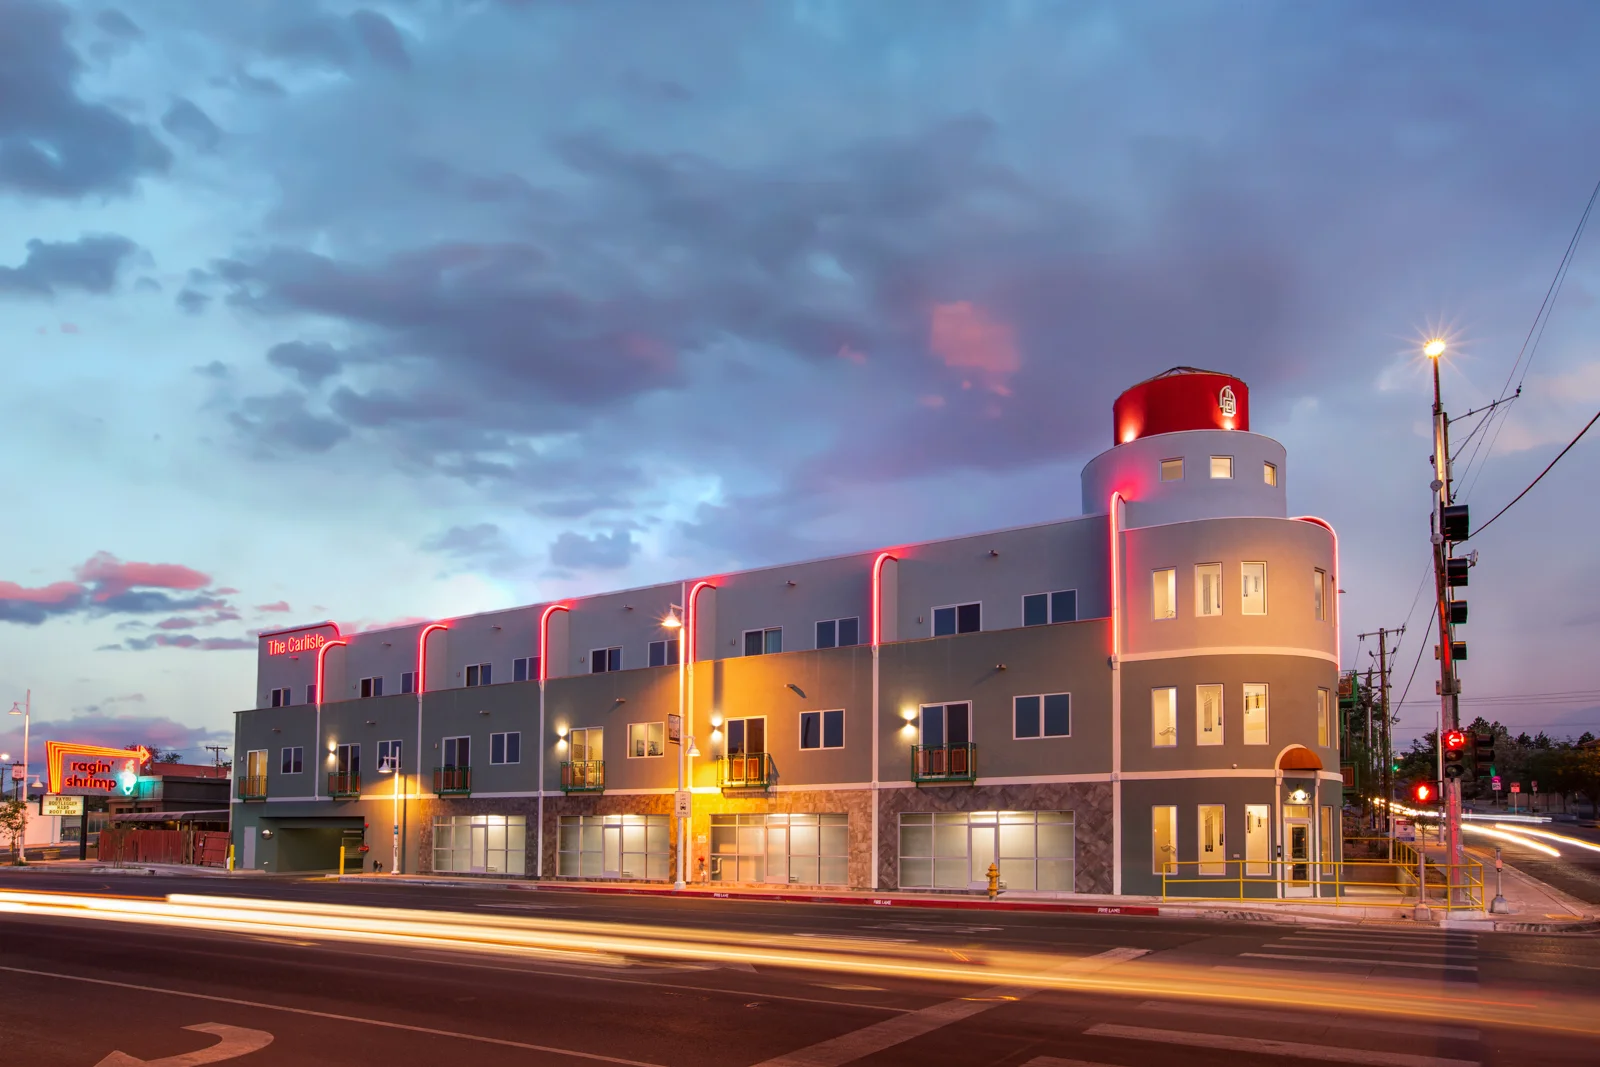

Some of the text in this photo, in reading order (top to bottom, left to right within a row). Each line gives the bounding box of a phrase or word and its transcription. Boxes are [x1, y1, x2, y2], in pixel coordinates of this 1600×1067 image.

[268, 633, 324, 655] The Carlisle
[71, 760, 114, 775] ragin'
[65, 774, 117, 792] shrimp
